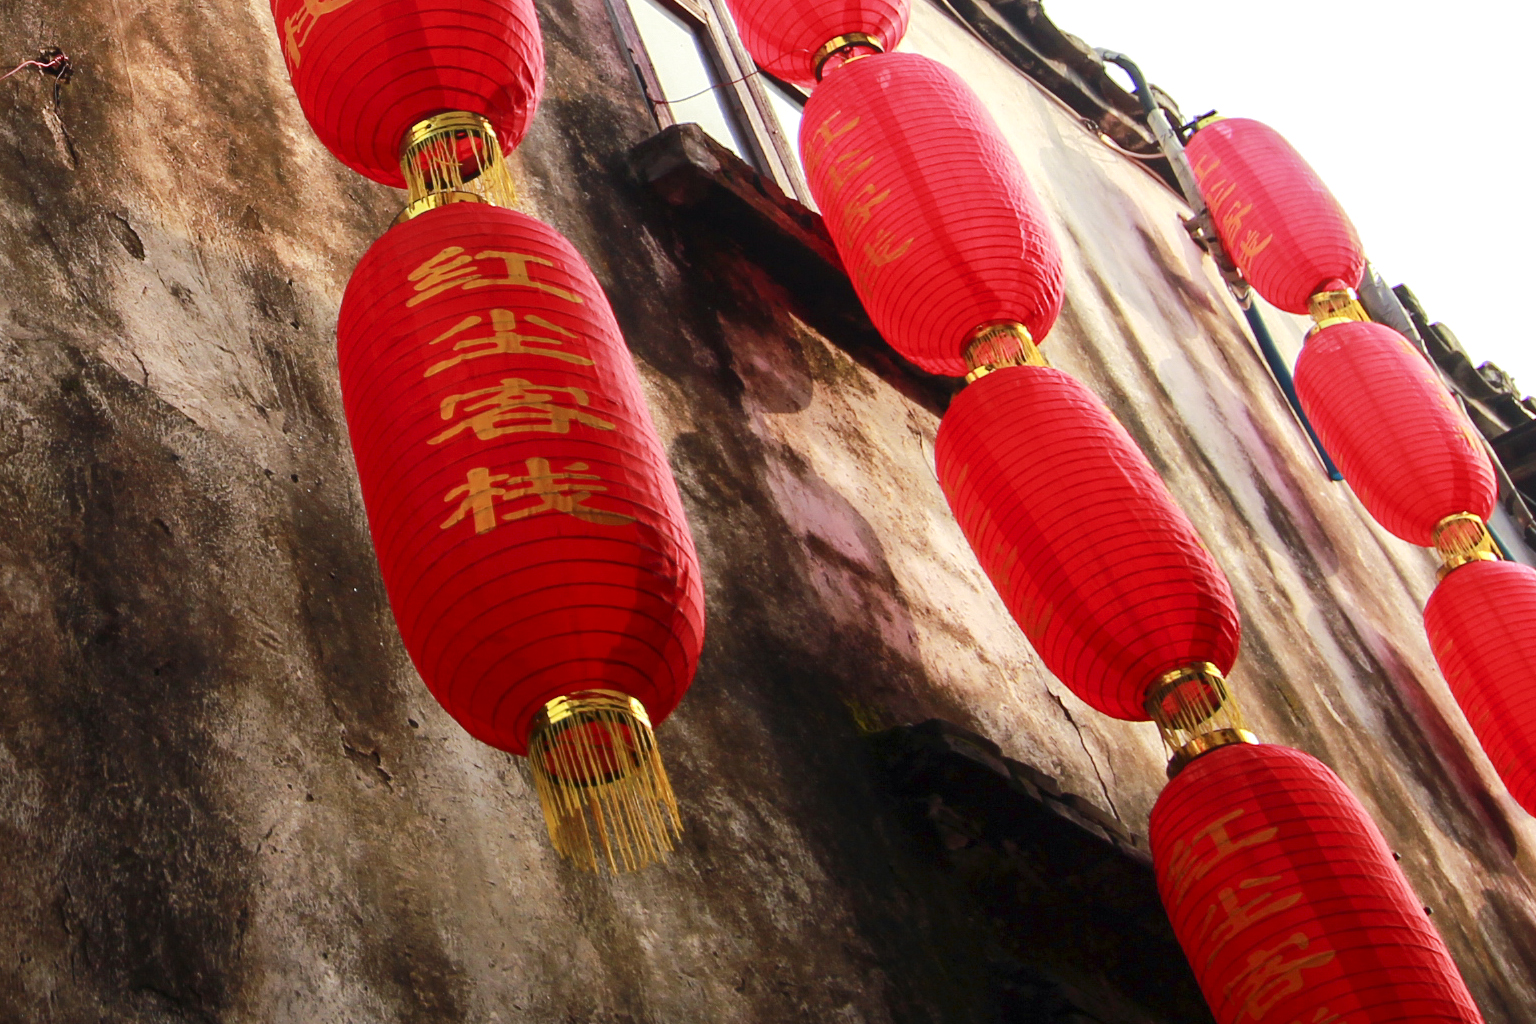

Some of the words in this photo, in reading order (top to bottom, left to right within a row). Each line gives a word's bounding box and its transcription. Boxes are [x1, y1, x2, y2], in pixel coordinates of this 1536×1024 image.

[406, 246, 638, 535] 红尘客栈
[1167, 808, 1347, 1024] 红尘客
